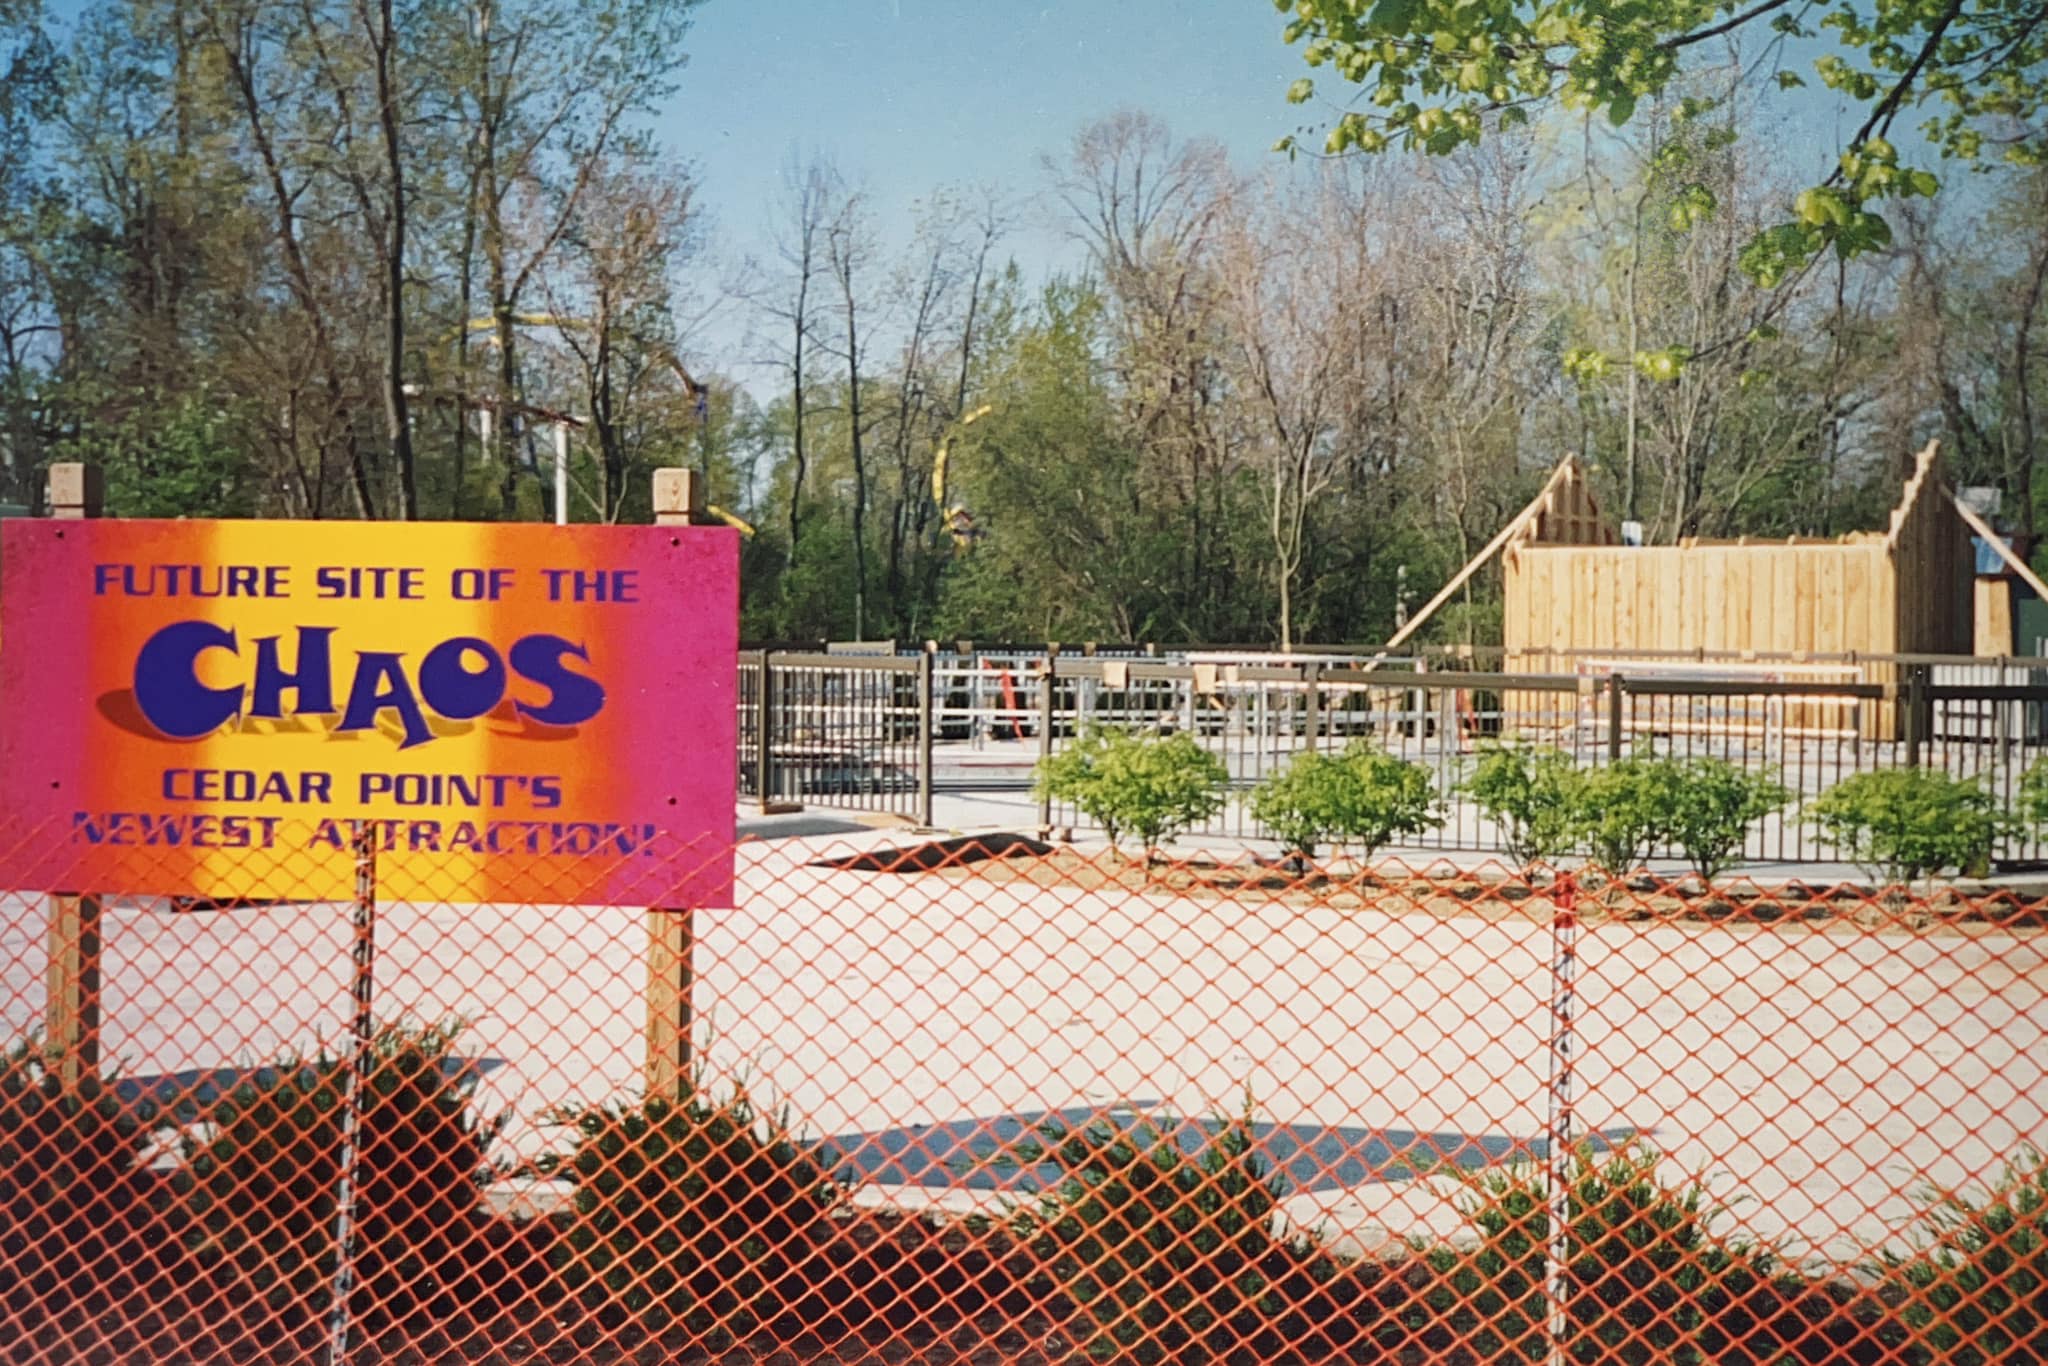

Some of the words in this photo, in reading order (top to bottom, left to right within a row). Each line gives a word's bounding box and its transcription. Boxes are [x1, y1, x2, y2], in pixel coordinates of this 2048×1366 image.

[95, 564, 290, 597] FUTURE
[317, 567, 425, 599] SITE
[452, 569, 514, 600] OF
[541, 569, 639, 602] THE
[135, 620, 606, 750] CHAOS
[163, 769, 332, 803] CEDAR
[360, 774, 561, 807] POINT'S
[72, 812, 282, 847] NEWEST
